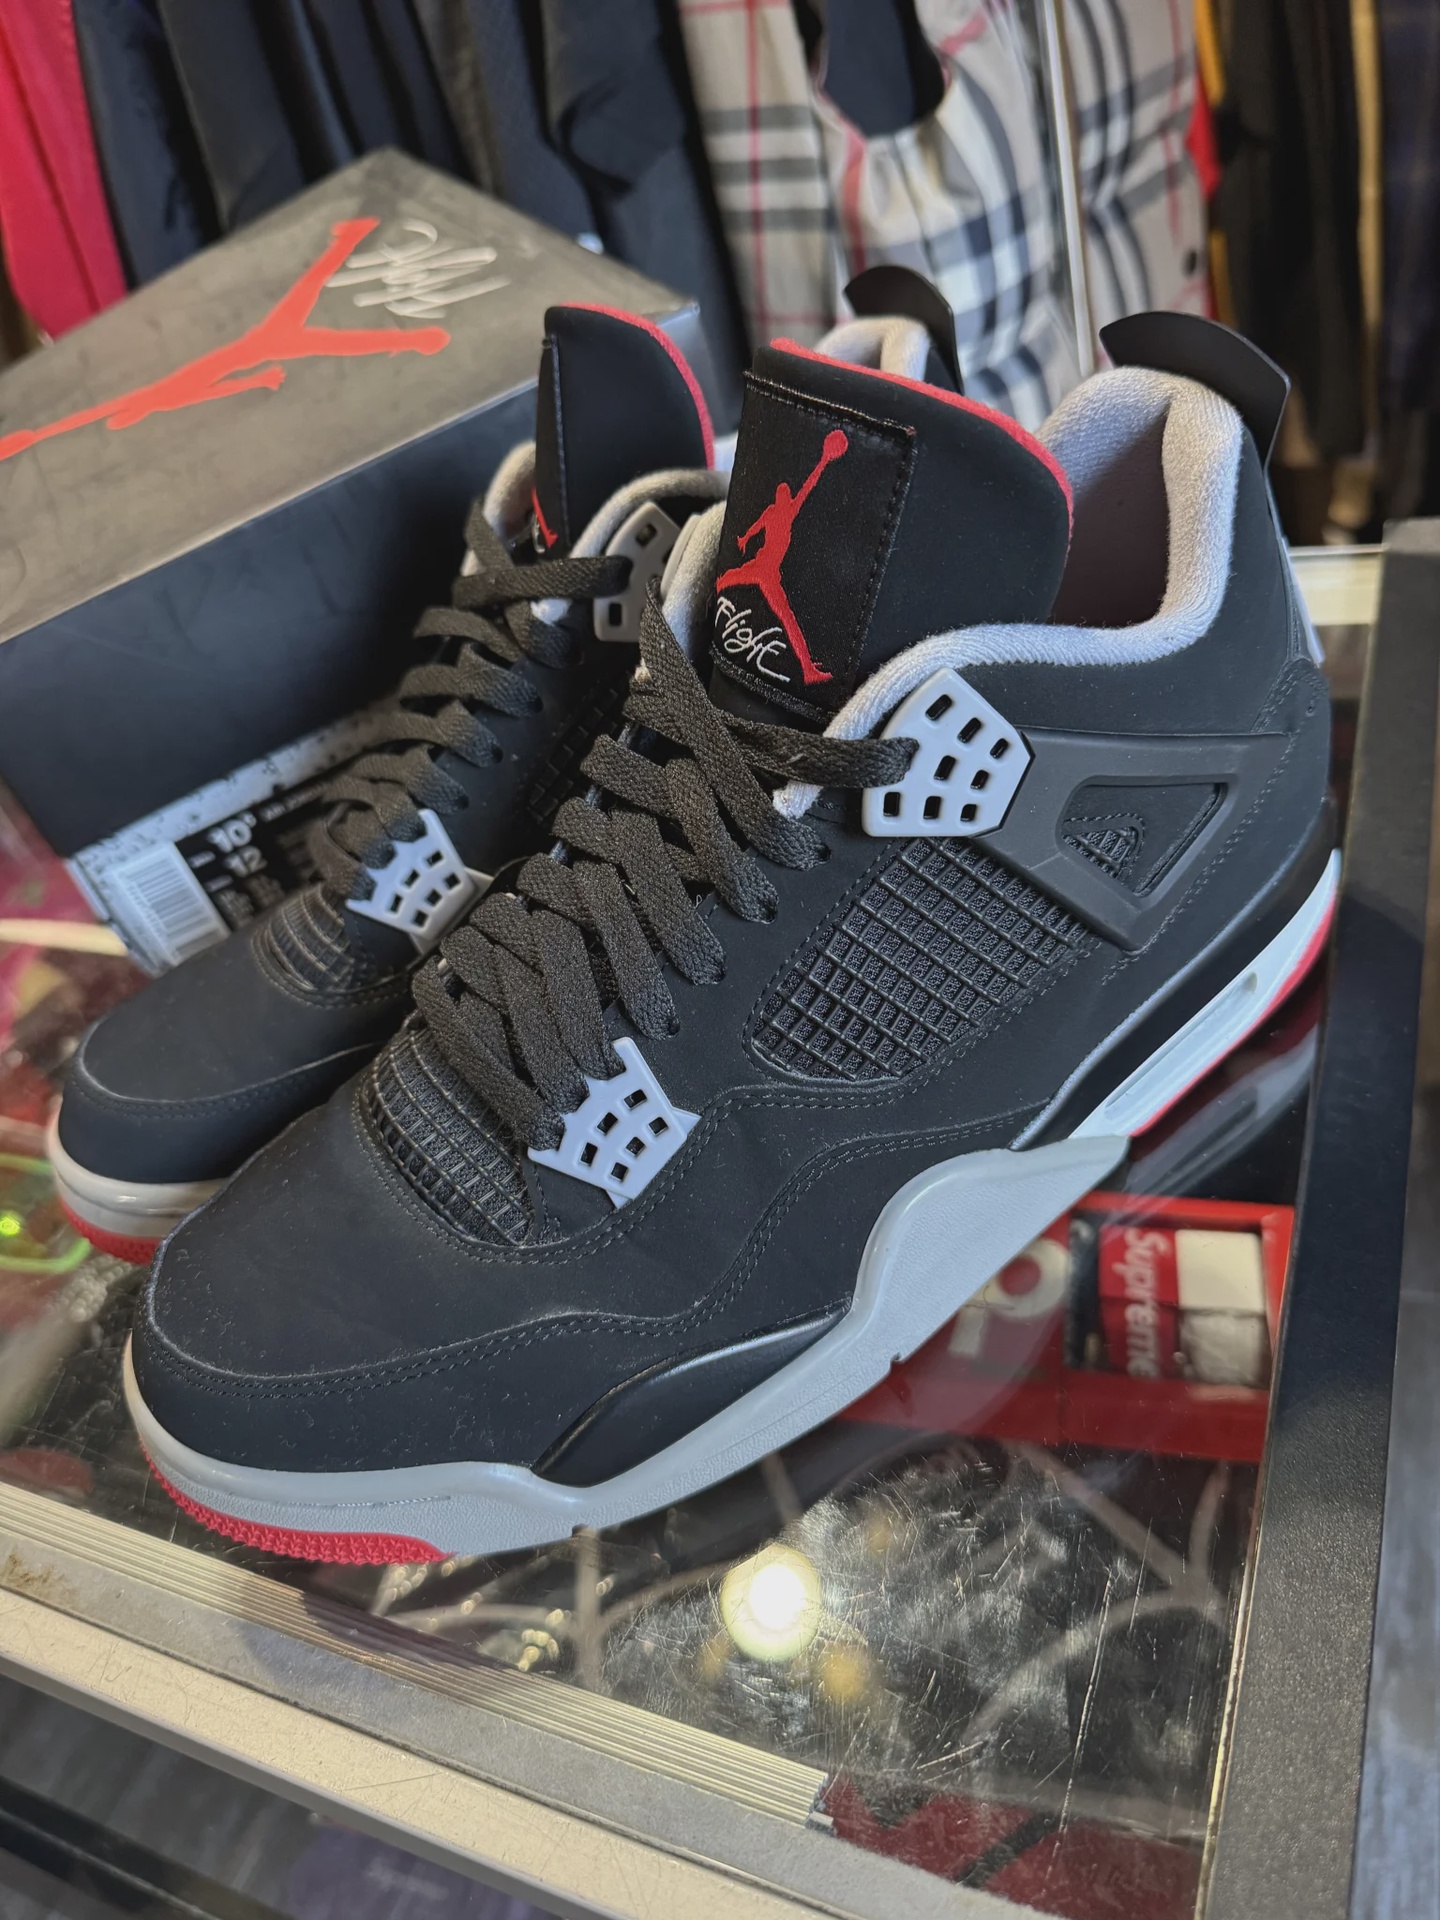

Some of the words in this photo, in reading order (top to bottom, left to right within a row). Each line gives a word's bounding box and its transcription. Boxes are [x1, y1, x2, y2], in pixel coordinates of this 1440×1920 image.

[714, 596, 791, 683] Flight
[224, 845, 268, 877] 12
[1111, 1228, 1170, 1379] Supreme
